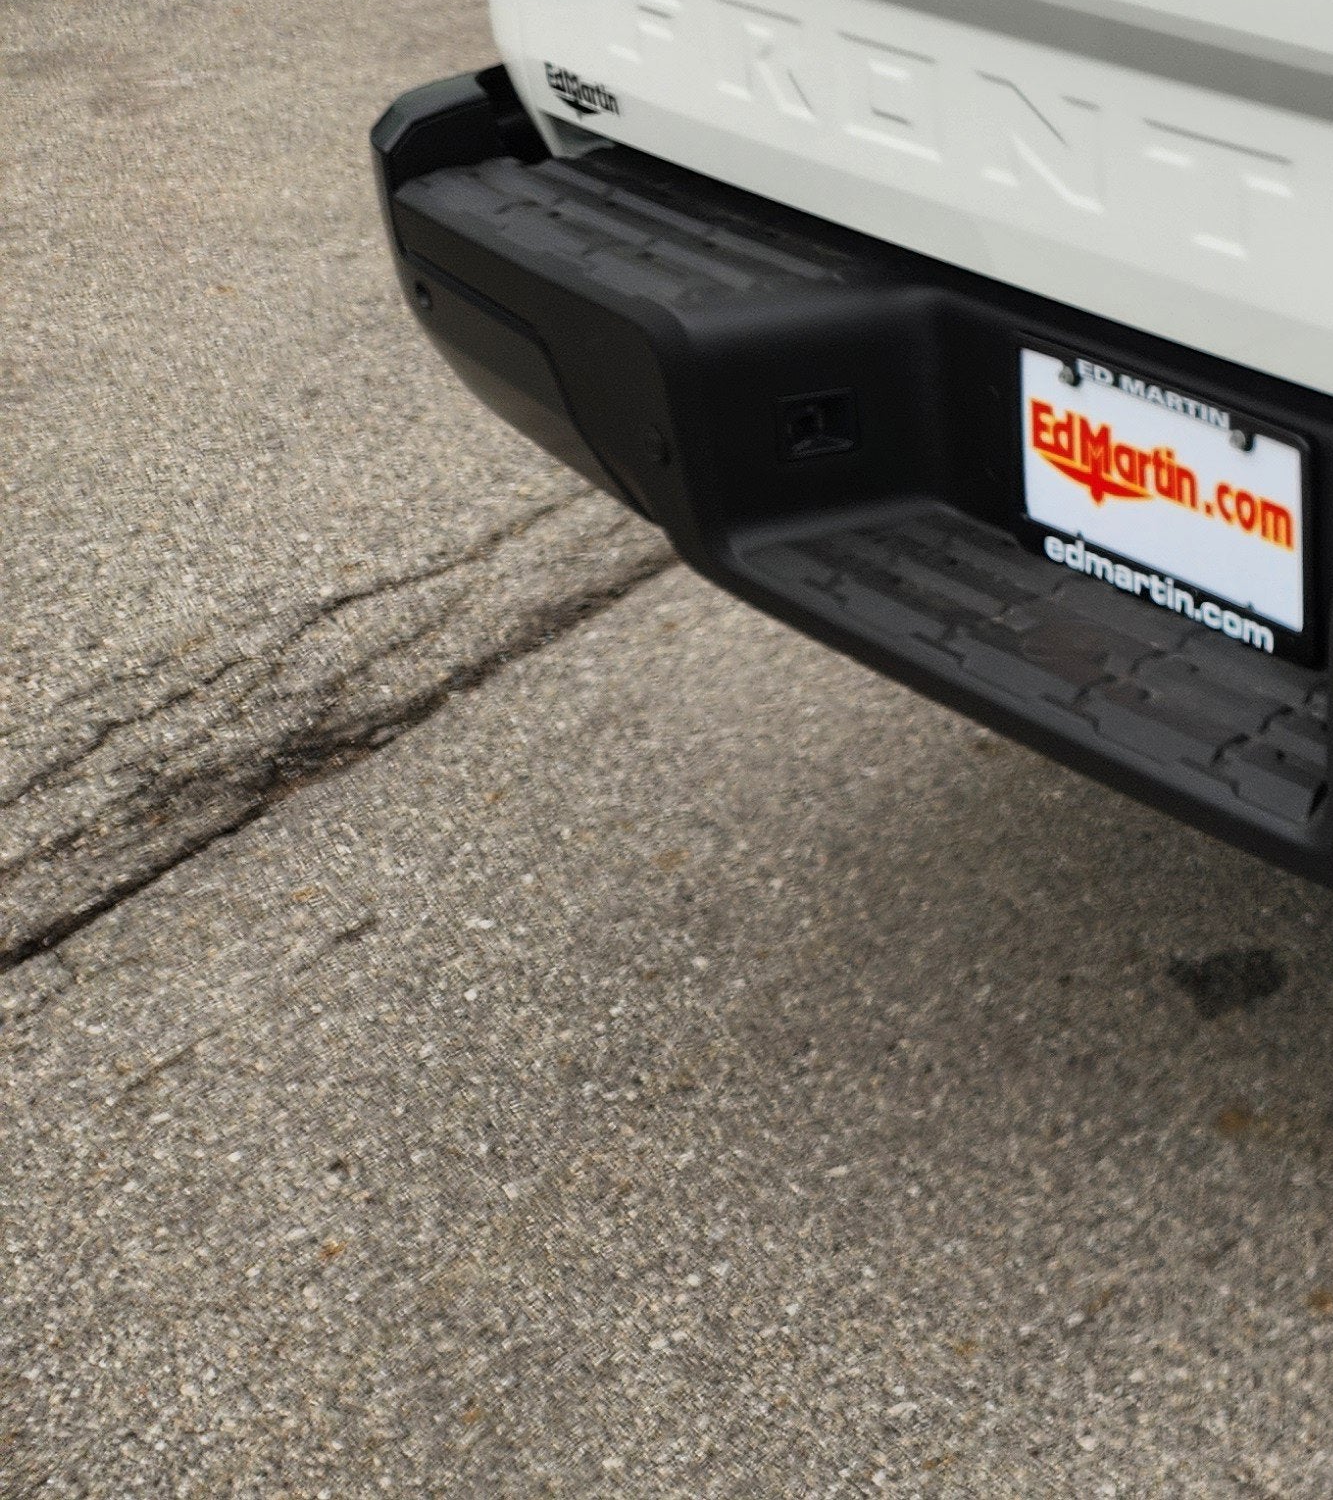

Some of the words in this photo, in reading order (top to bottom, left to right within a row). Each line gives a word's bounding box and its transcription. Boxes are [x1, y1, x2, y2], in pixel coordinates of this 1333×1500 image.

[1076, 358, 1114, 385] ED
[1119, 375, 1230, 430] MARTIN
[1044, 535, 1275, 654] edmartin.com
